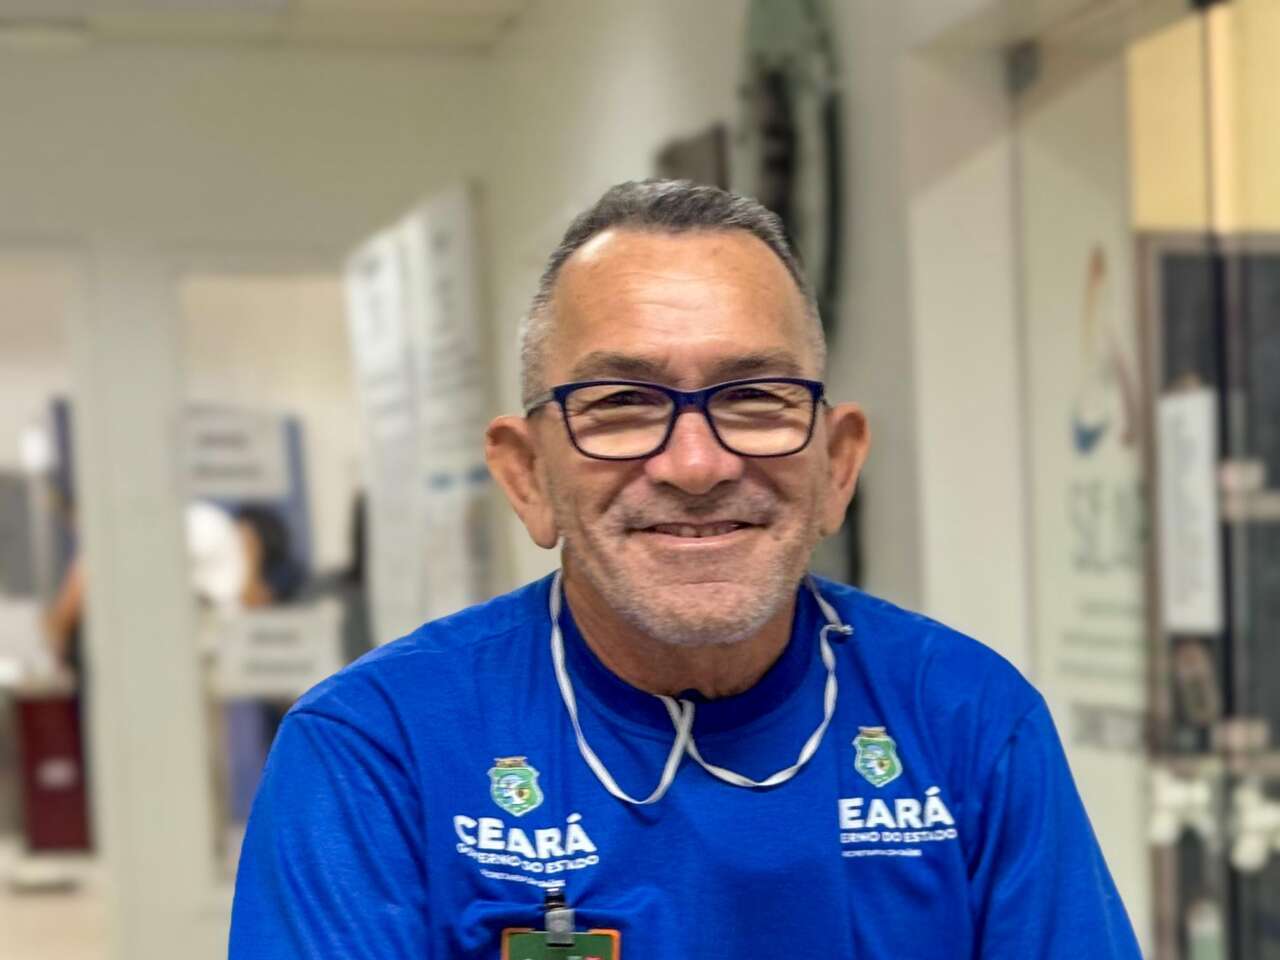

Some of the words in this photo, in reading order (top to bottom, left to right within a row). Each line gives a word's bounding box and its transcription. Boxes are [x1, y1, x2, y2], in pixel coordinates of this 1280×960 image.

[838, 786, 955, 829] EARÁ
[453, 813, 598, 859] CEARÁ
[881, 831, 903, 843] DO
[903, 828, 958, 843] ESTADO
[456, 842, 521, 868] GERNO
[545, 854, 600, 874] ESTADO
